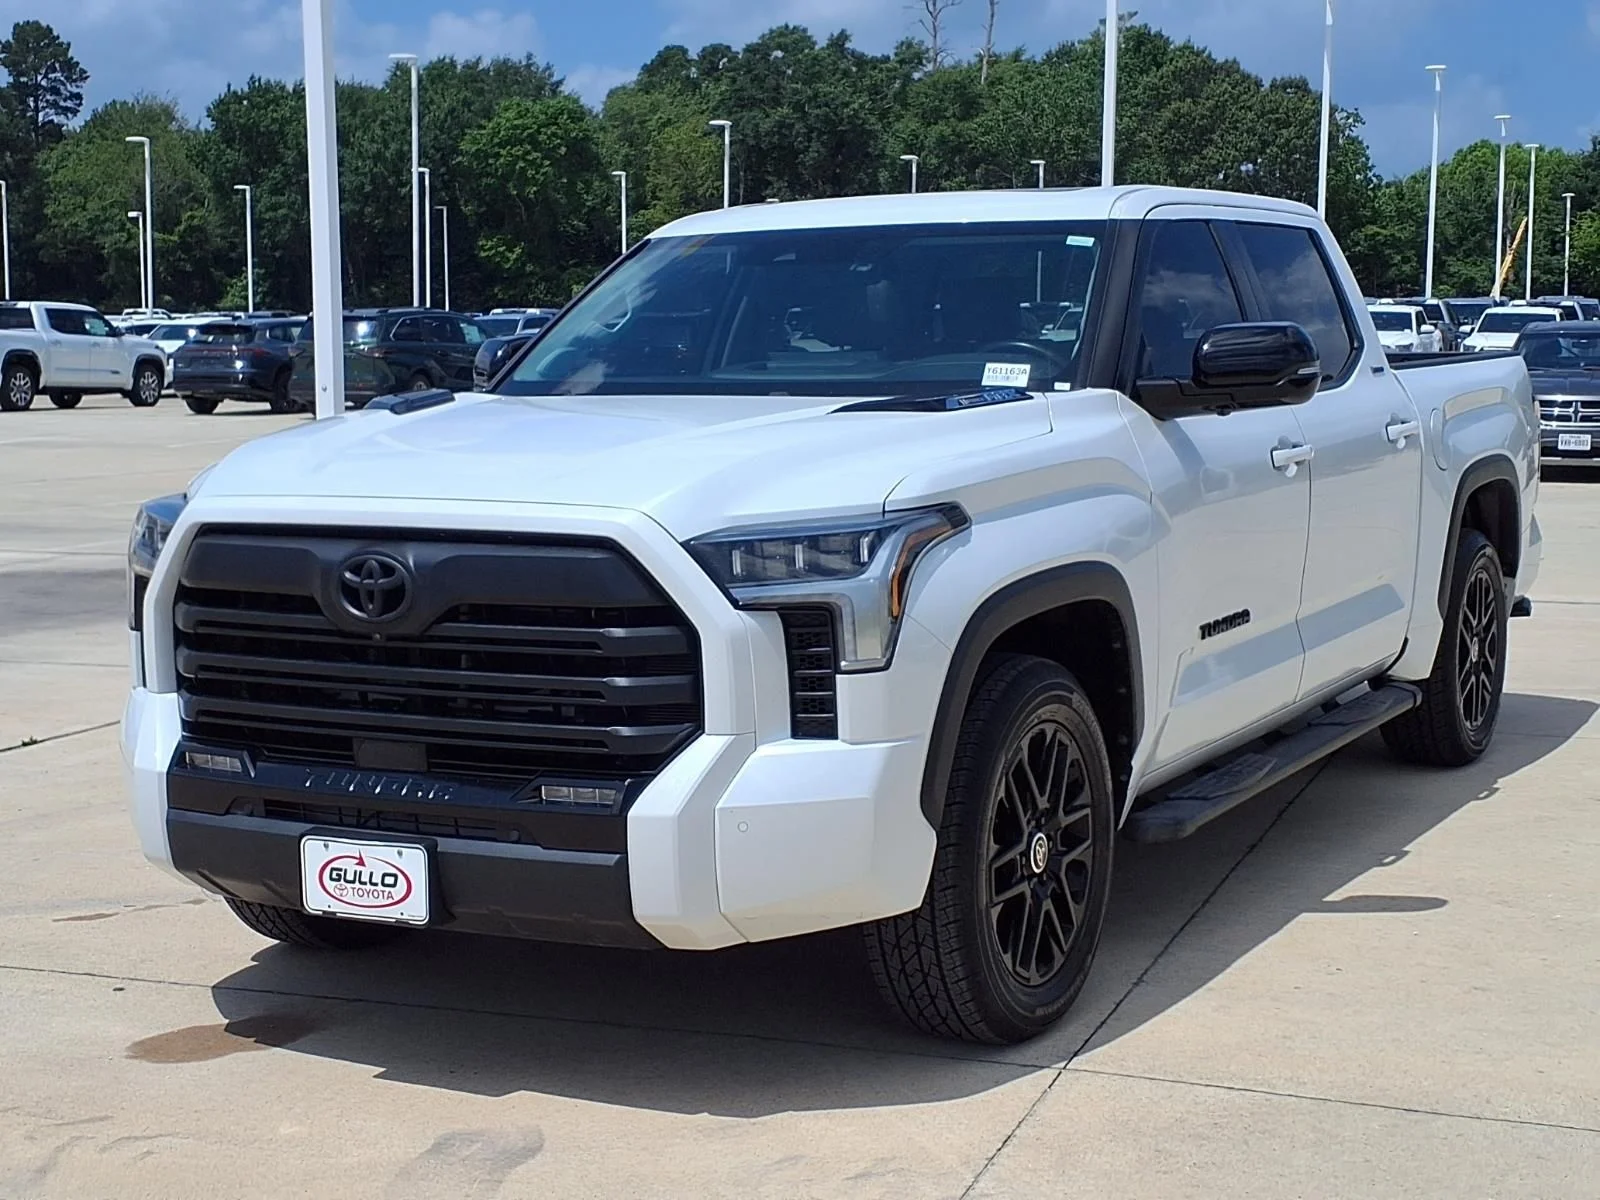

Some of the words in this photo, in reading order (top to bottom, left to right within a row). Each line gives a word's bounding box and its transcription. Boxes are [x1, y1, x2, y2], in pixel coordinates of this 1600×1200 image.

[1199, 608, 1250, 641] TUNDRA
[328, 866, 399, 889] GULLO
[350, 886, 395, 901] TOYOTA
